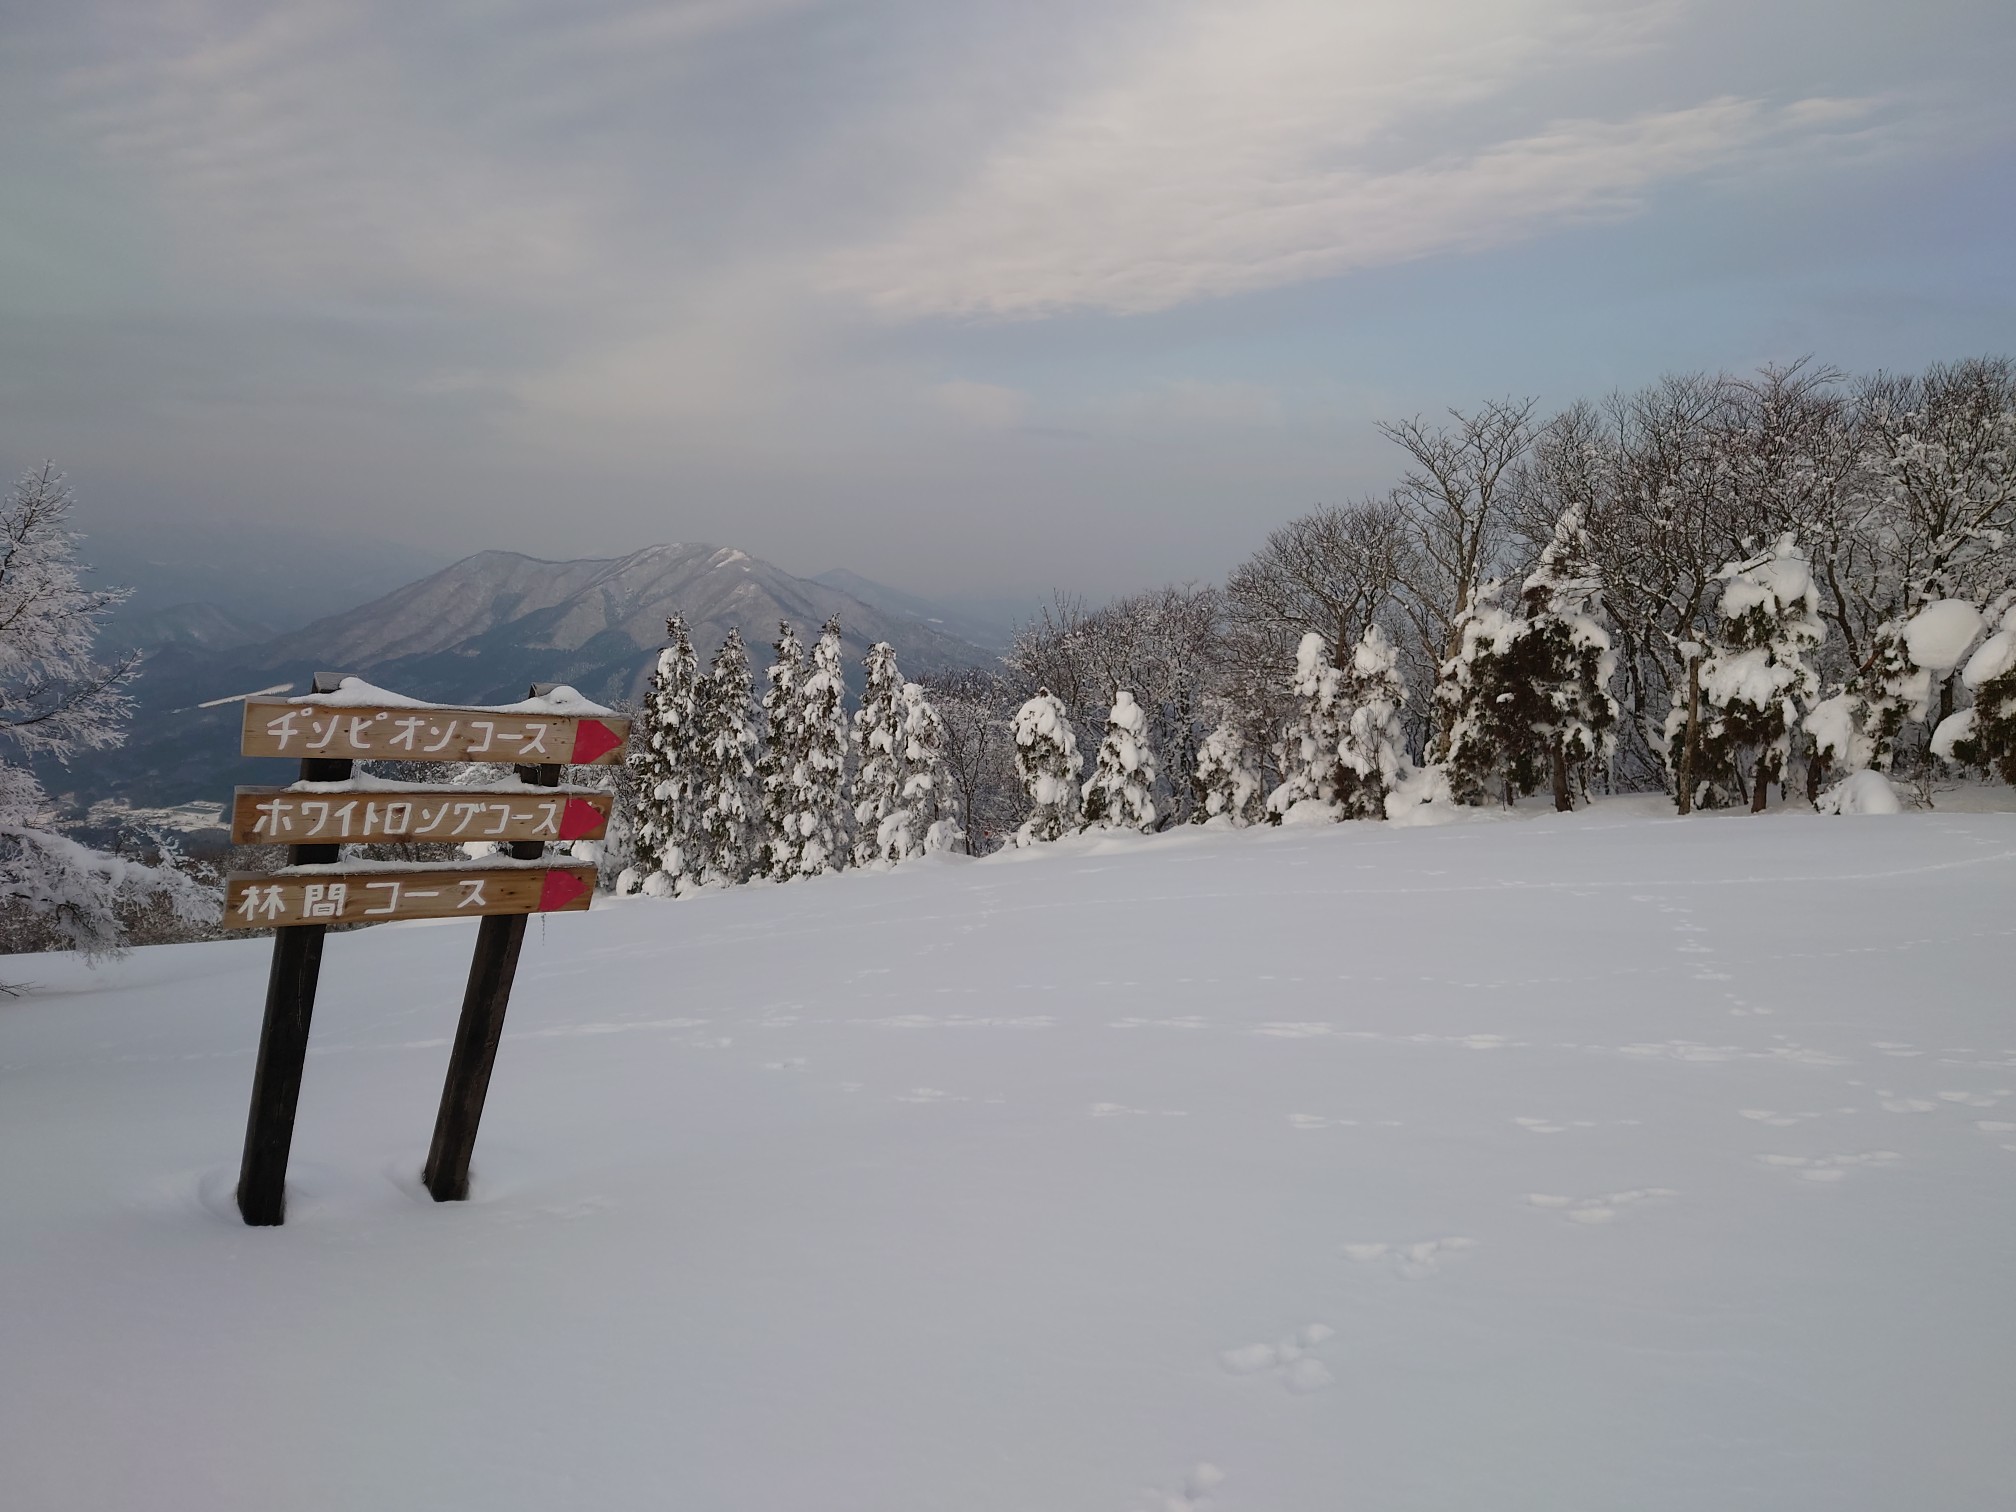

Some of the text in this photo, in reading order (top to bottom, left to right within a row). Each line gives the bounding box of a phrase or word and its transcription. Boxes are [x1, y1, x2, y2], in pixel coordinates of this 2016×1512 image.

[253, 798, 557, 836] ホワイトロングコース
[238, 880, 486, 921] 林間コース
